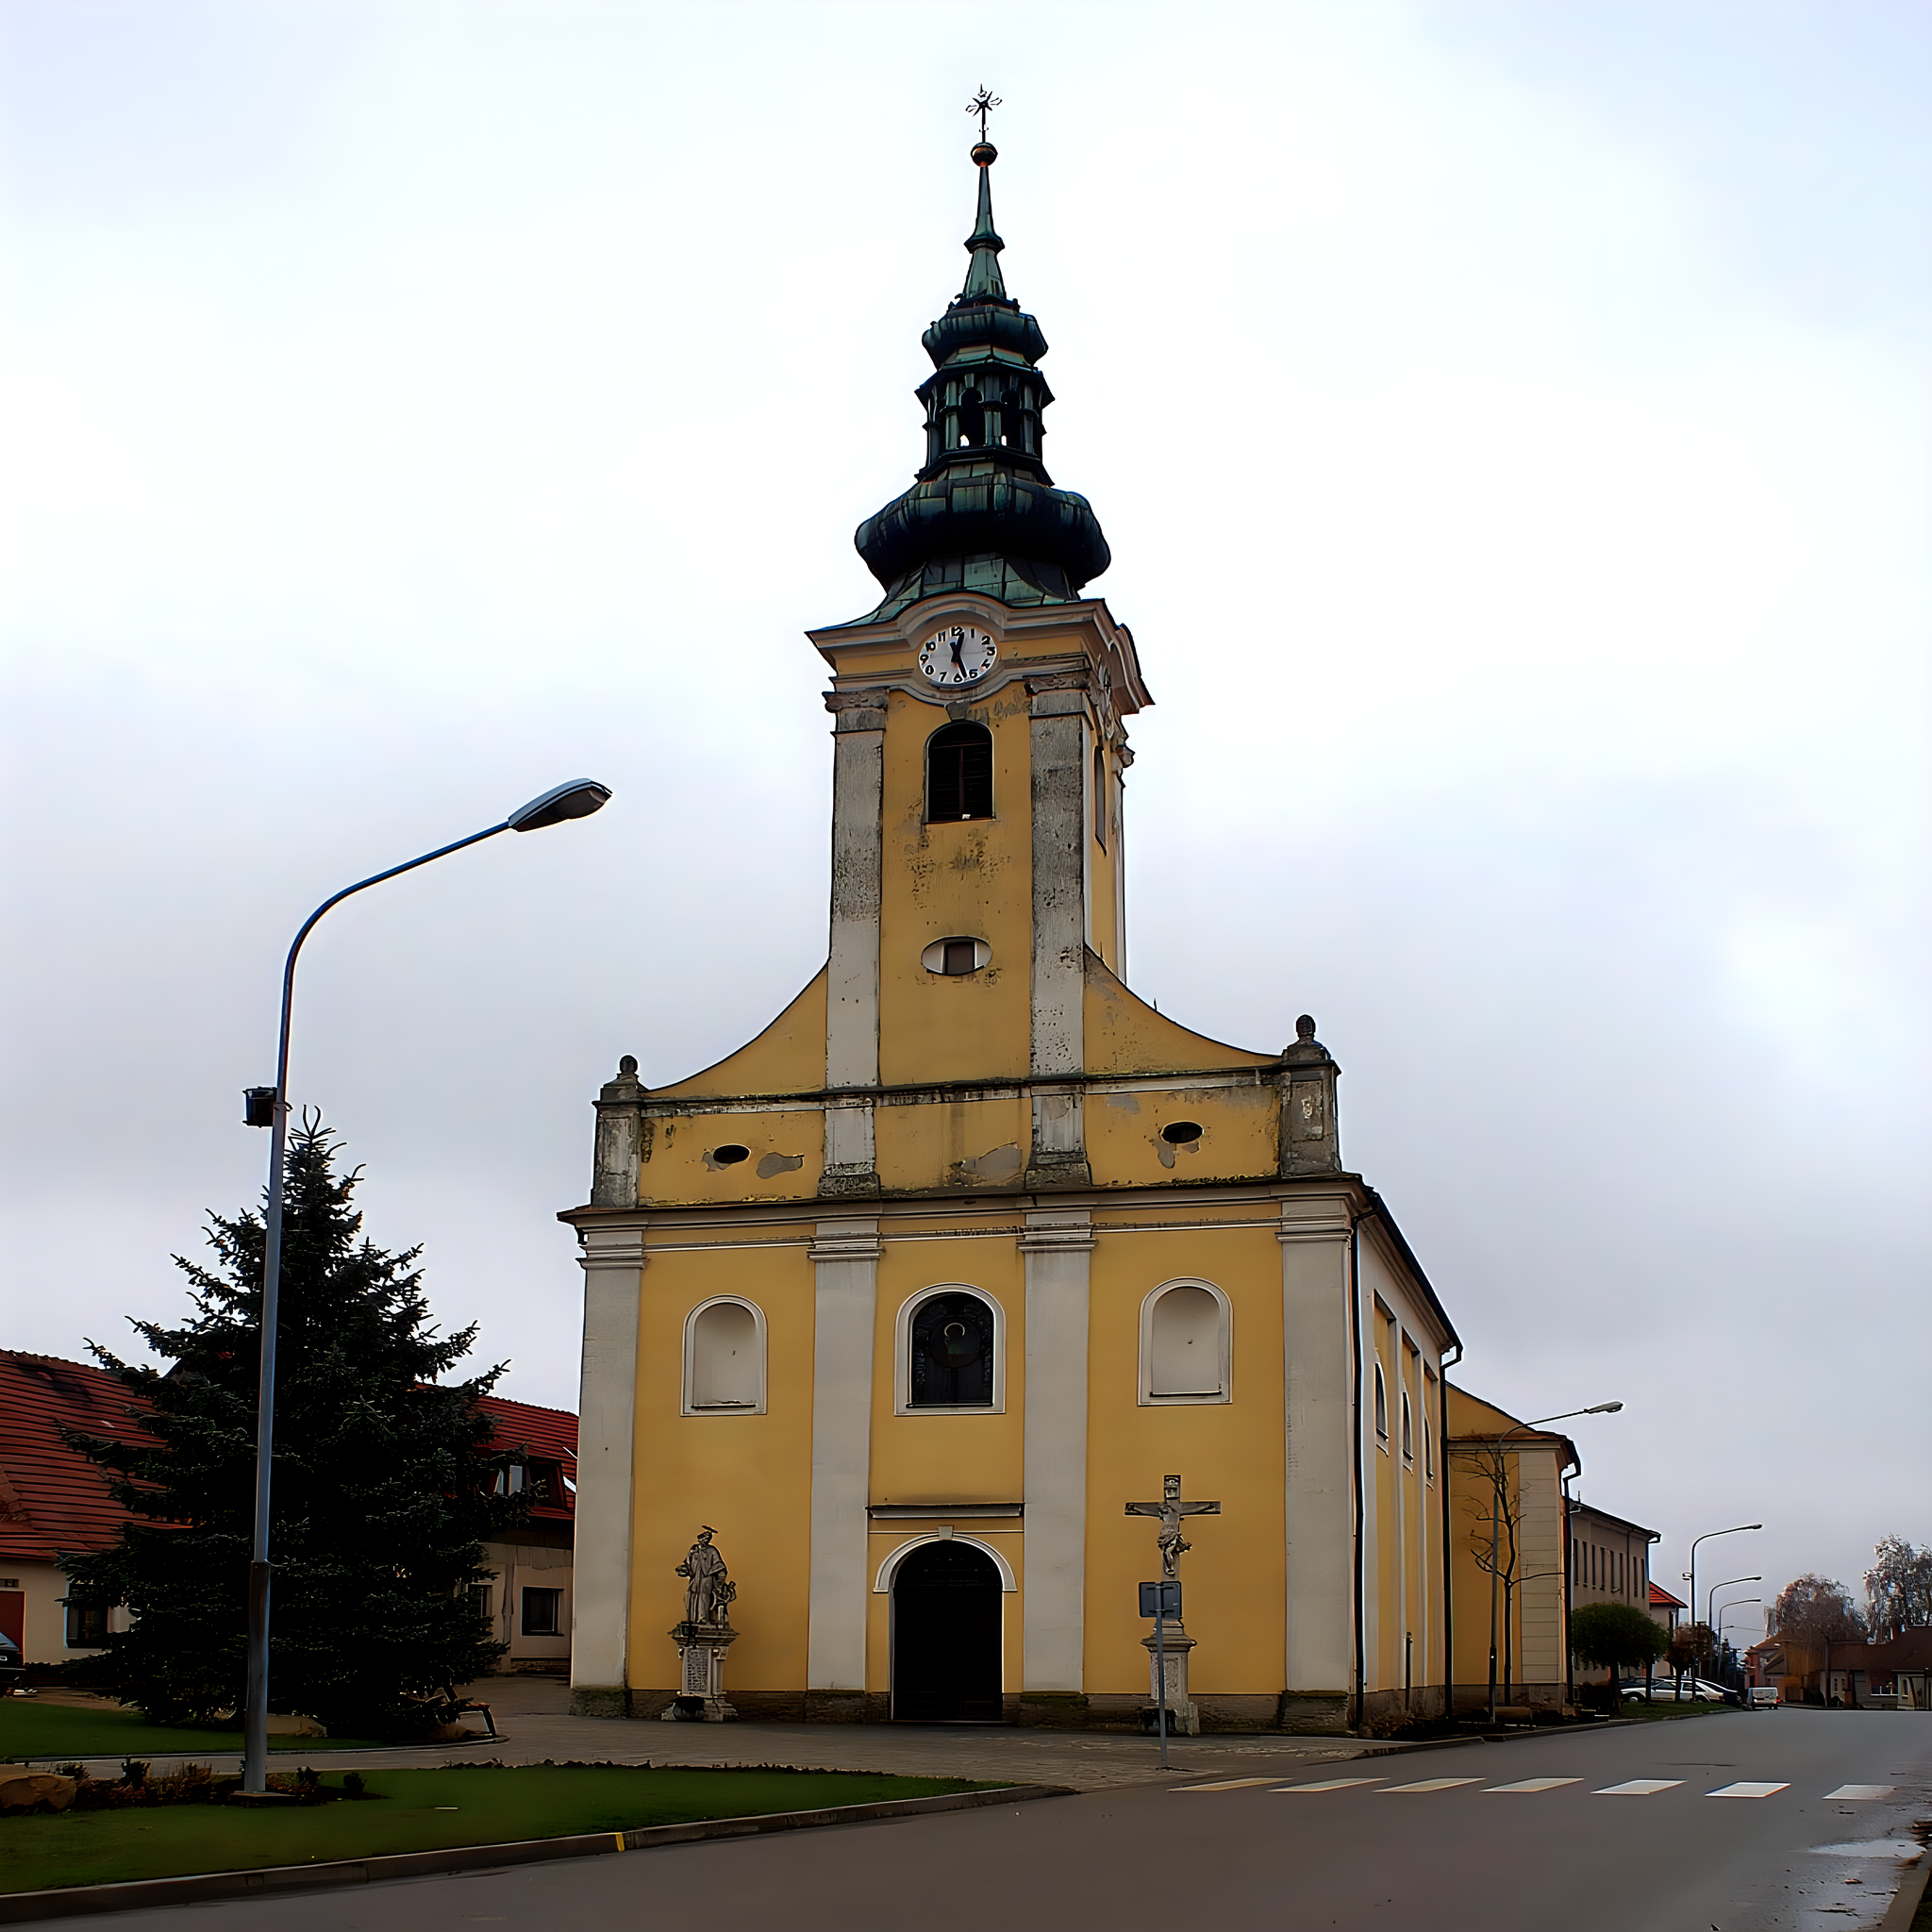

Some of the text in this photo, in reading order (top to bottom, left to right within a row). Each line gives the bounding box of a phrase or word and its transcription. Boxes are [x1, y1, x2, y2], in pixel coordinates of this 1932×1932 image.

[938, 631, 946, 641] 11
[951, 626, 964, 637] 12
[971, 628, 975, 639] 1
[981, 635, 991, 645] 2
[987, 646, 995, 656] 3
[920, 654, 929, 665] 9
[981, 658, 991, 669] 4
[940, 672, 947, 682] 7
